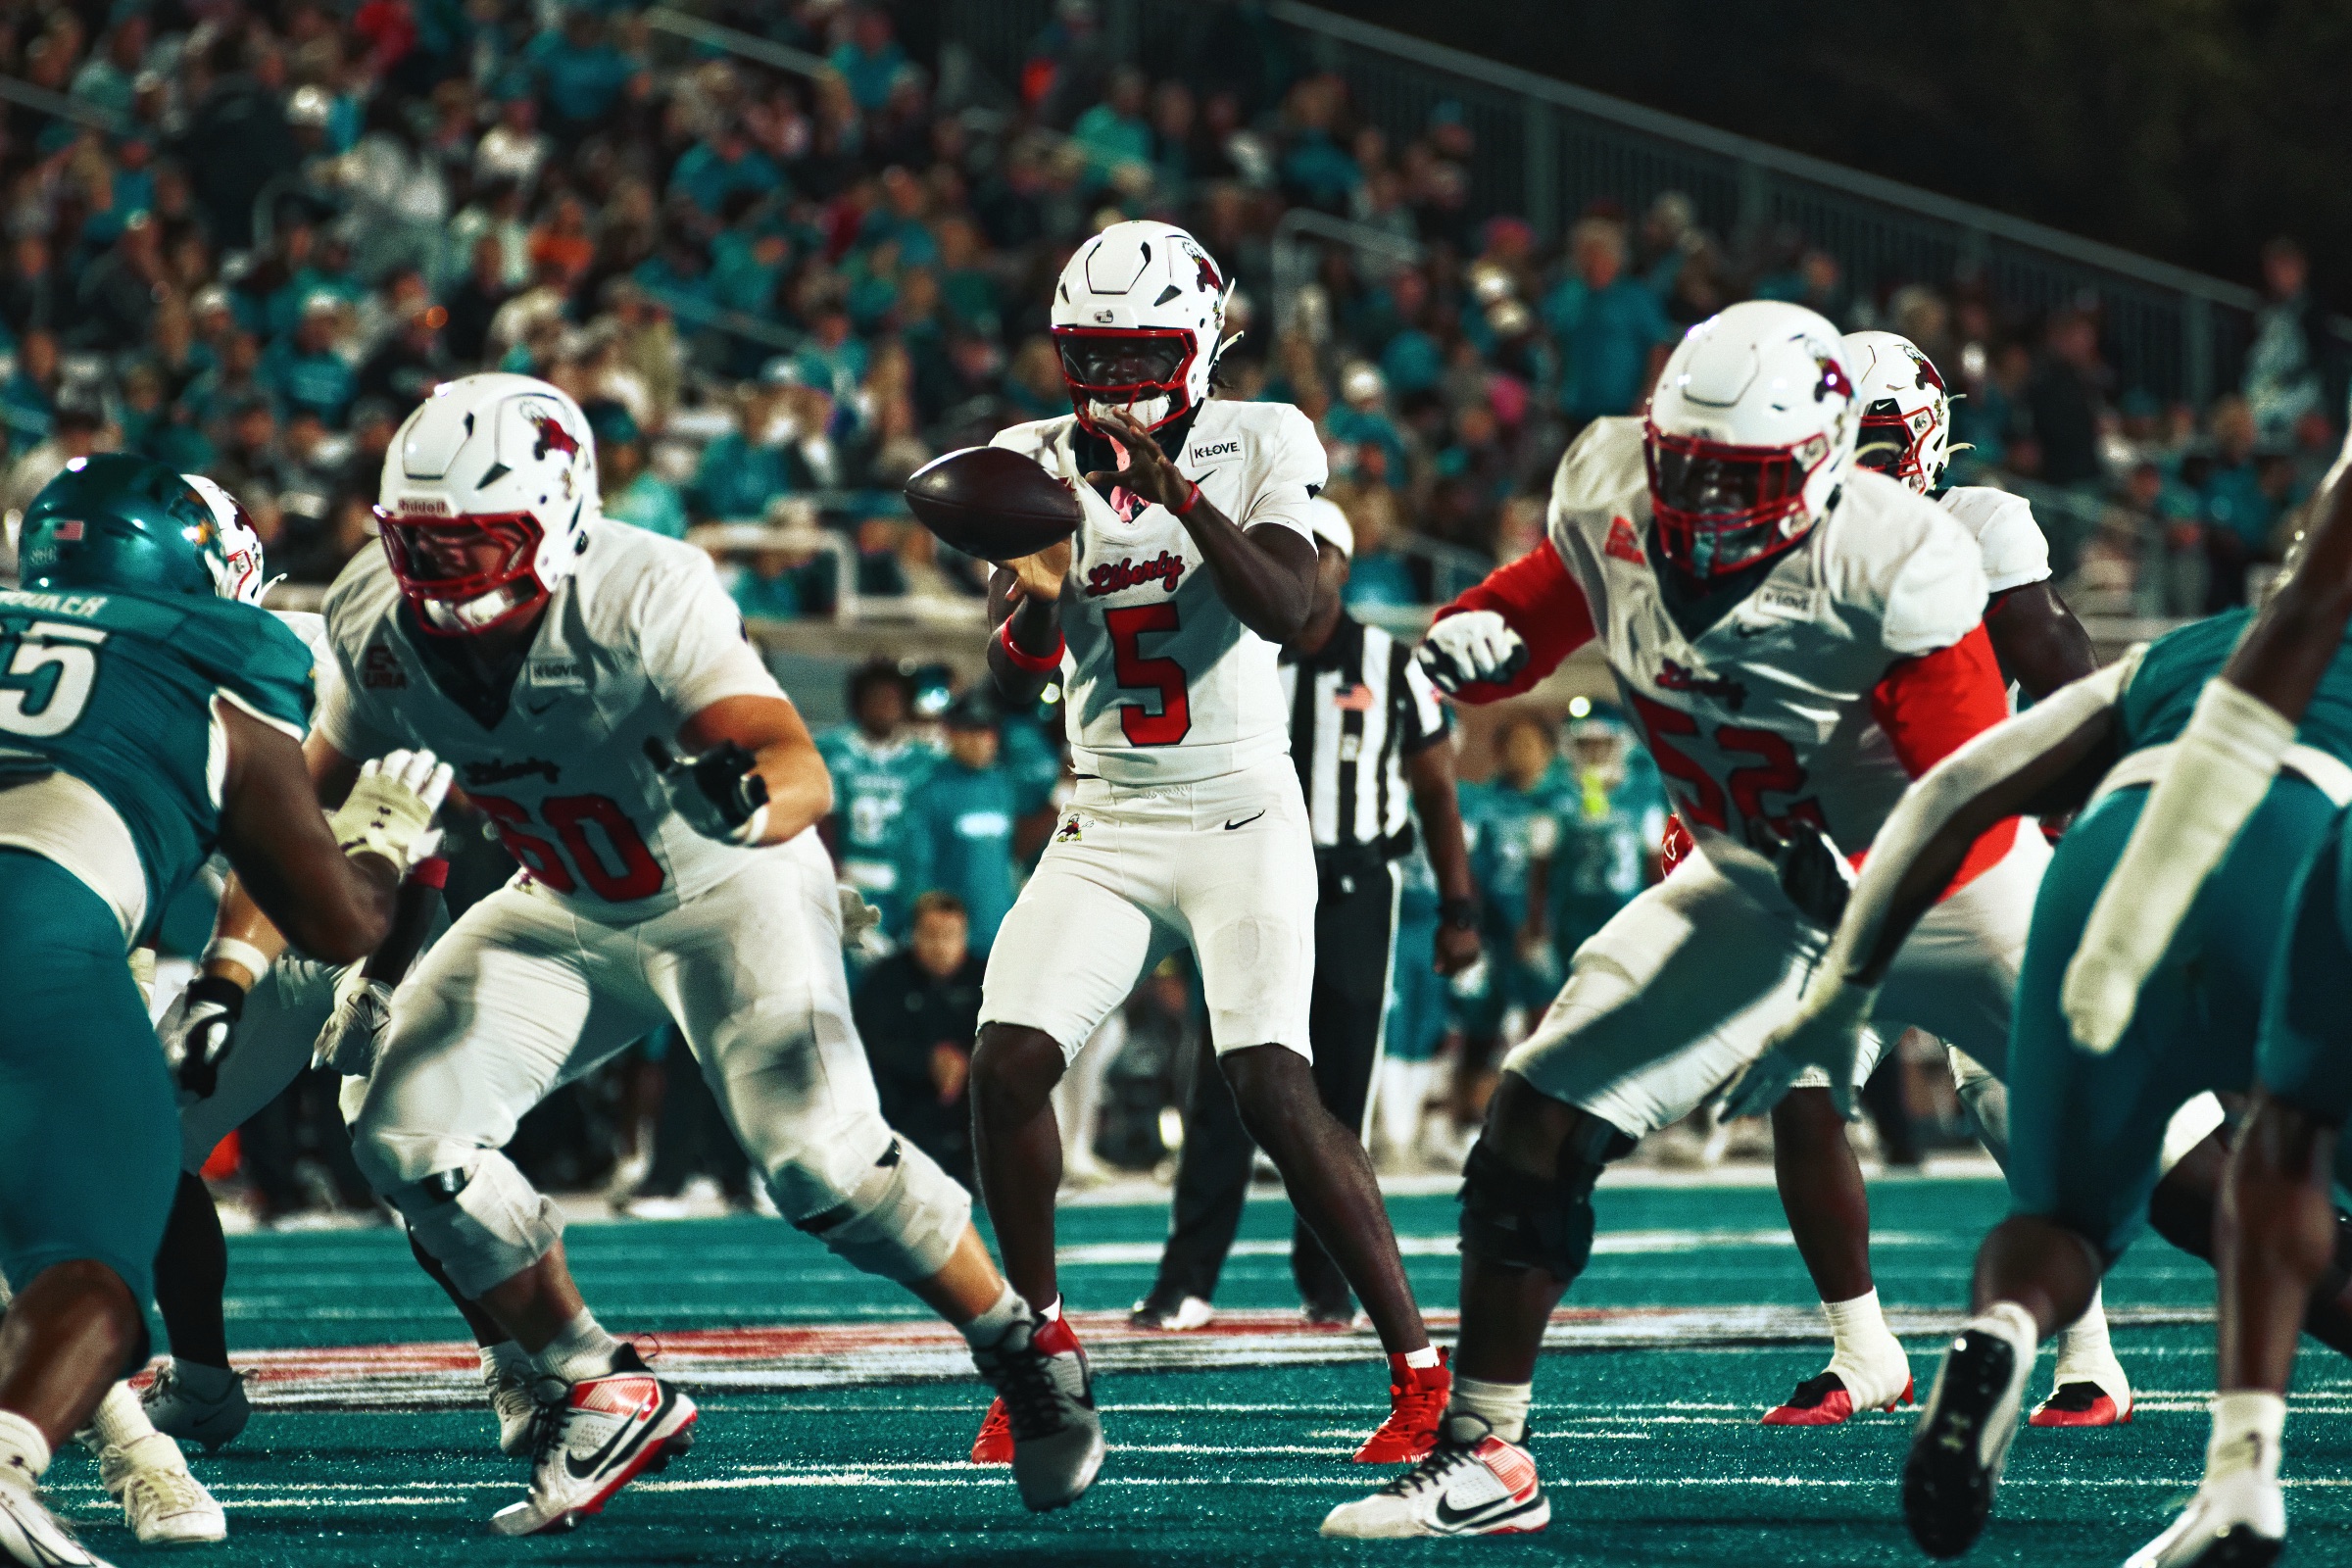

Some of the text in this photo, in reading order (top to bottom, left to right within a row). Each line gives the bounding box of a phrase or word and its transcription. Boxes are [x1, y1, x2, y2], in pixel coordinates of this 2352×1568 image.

[1087, 551, 1185, 597] Liberty
[1102, 601, 1192, 747] 5
[1628, 688, 1829, 841] 52
[465, 794, 665, 903] 60
